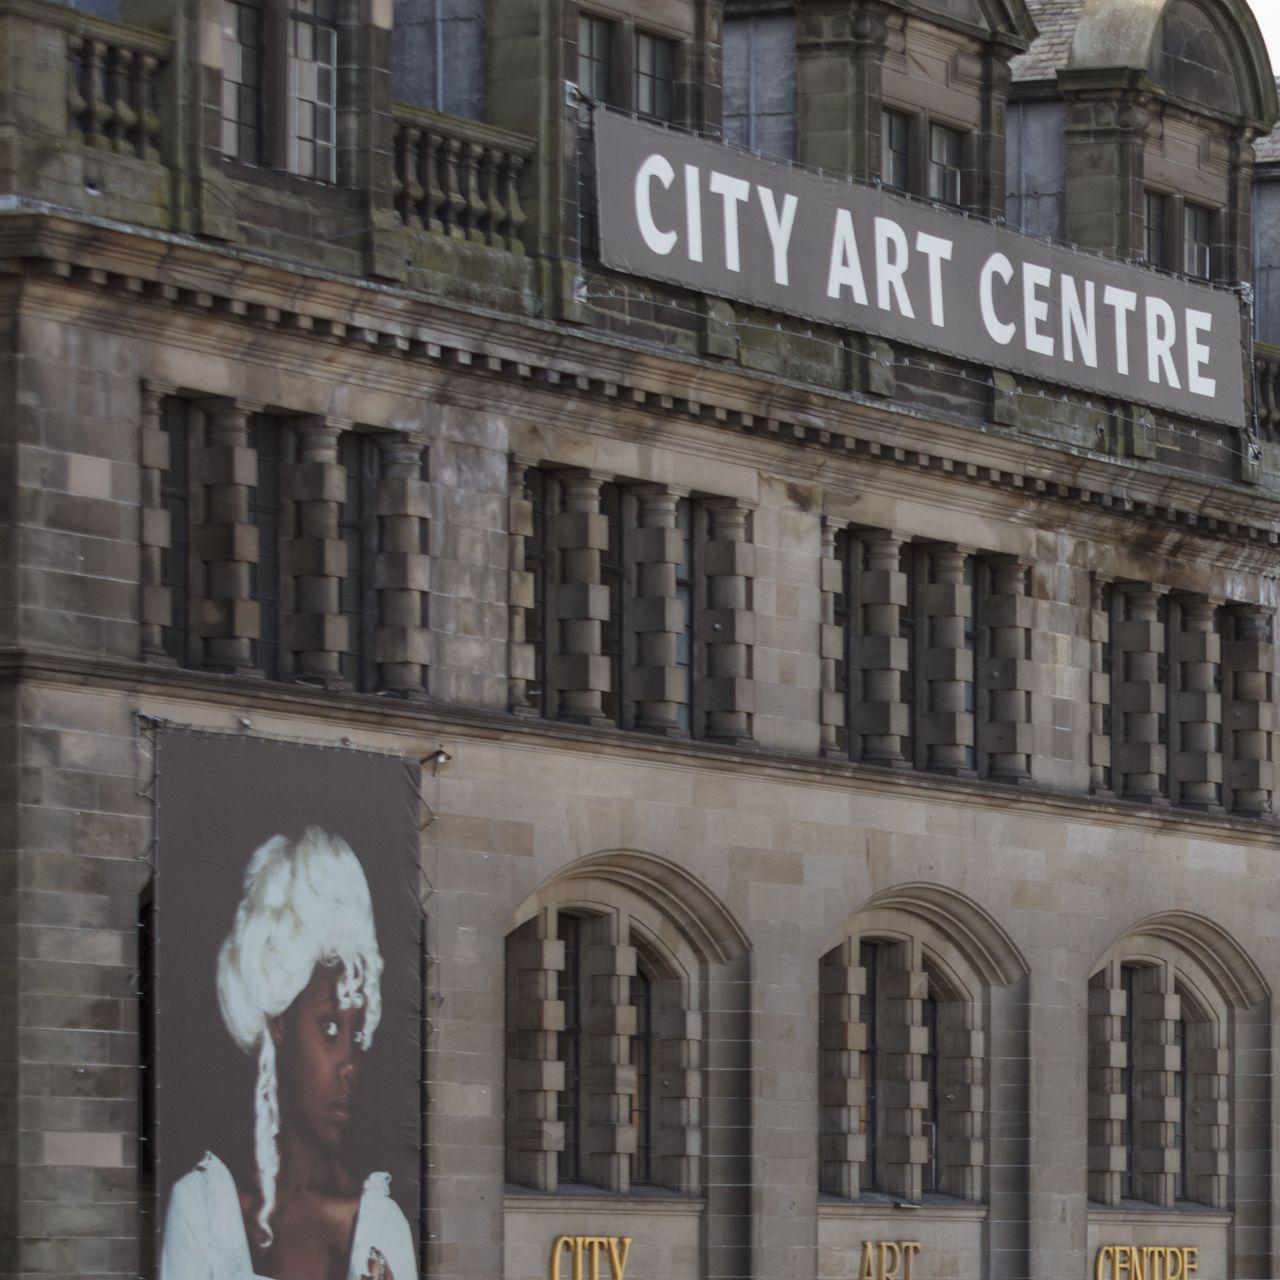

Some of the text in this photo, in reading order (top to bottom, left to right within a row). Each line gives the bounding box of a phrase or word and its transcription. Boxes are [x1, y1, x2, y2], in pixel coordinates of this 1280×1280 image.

[635, 154, 1217, 398] CITY ART CENTRE
